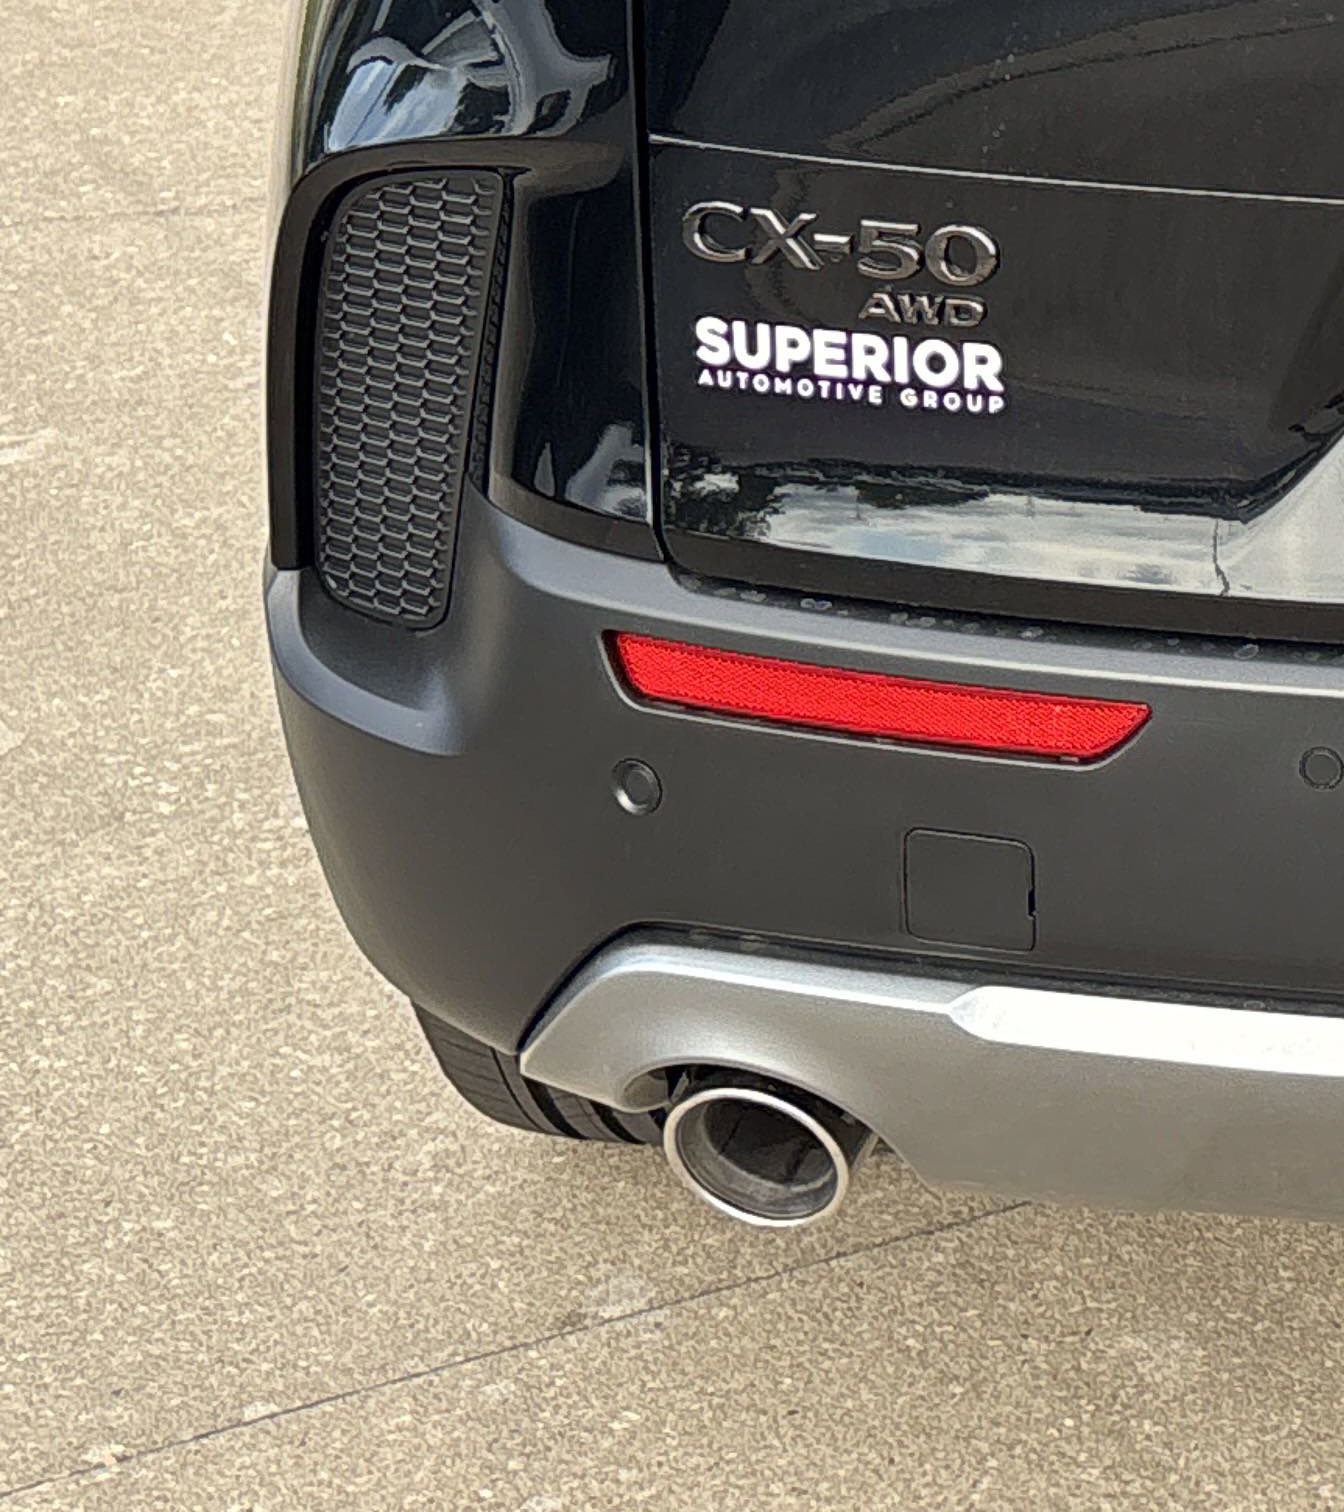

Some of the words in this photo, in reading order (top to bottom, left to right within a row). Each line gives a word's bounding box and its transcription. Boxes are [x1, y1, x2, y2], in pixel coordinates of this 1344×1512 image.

[682, 199, 999, 287] CX-50
[857, 291, 988, 327] AWD
[695, 316, 1004, 392] SUPERIOR
[698, 369, 883, 405] AUTOMOTIVE
[899, 387, 1005, 414] GROUP
